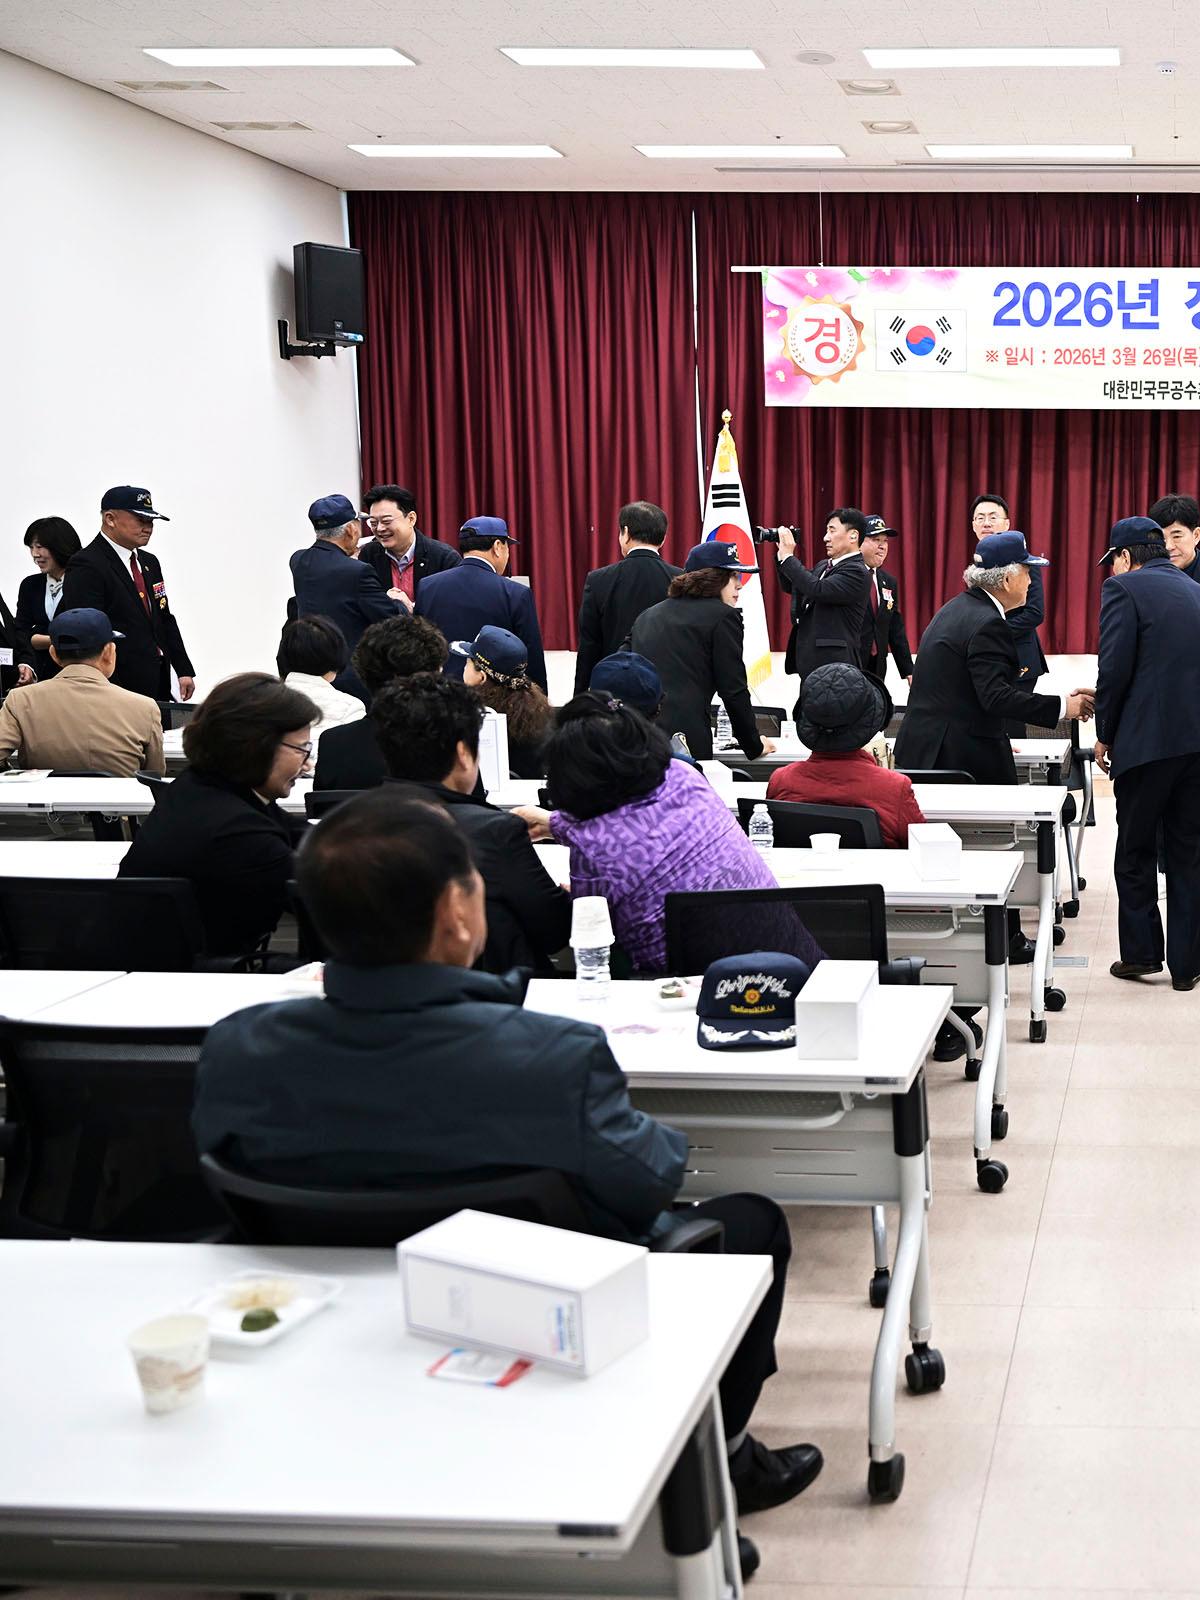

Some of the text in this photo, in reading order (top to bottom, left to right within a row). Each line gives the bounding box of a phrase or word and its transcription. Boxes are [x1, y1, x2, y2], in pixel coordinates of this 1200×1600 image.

[992, 278, 1160, 330] 2026년
[804, 317, 841, 364] 경
[1004, 347, 1034, 366] 일시
[1053, 347, 1106, 366] 2026년
[1112, 347, 1137, 366] 3월
